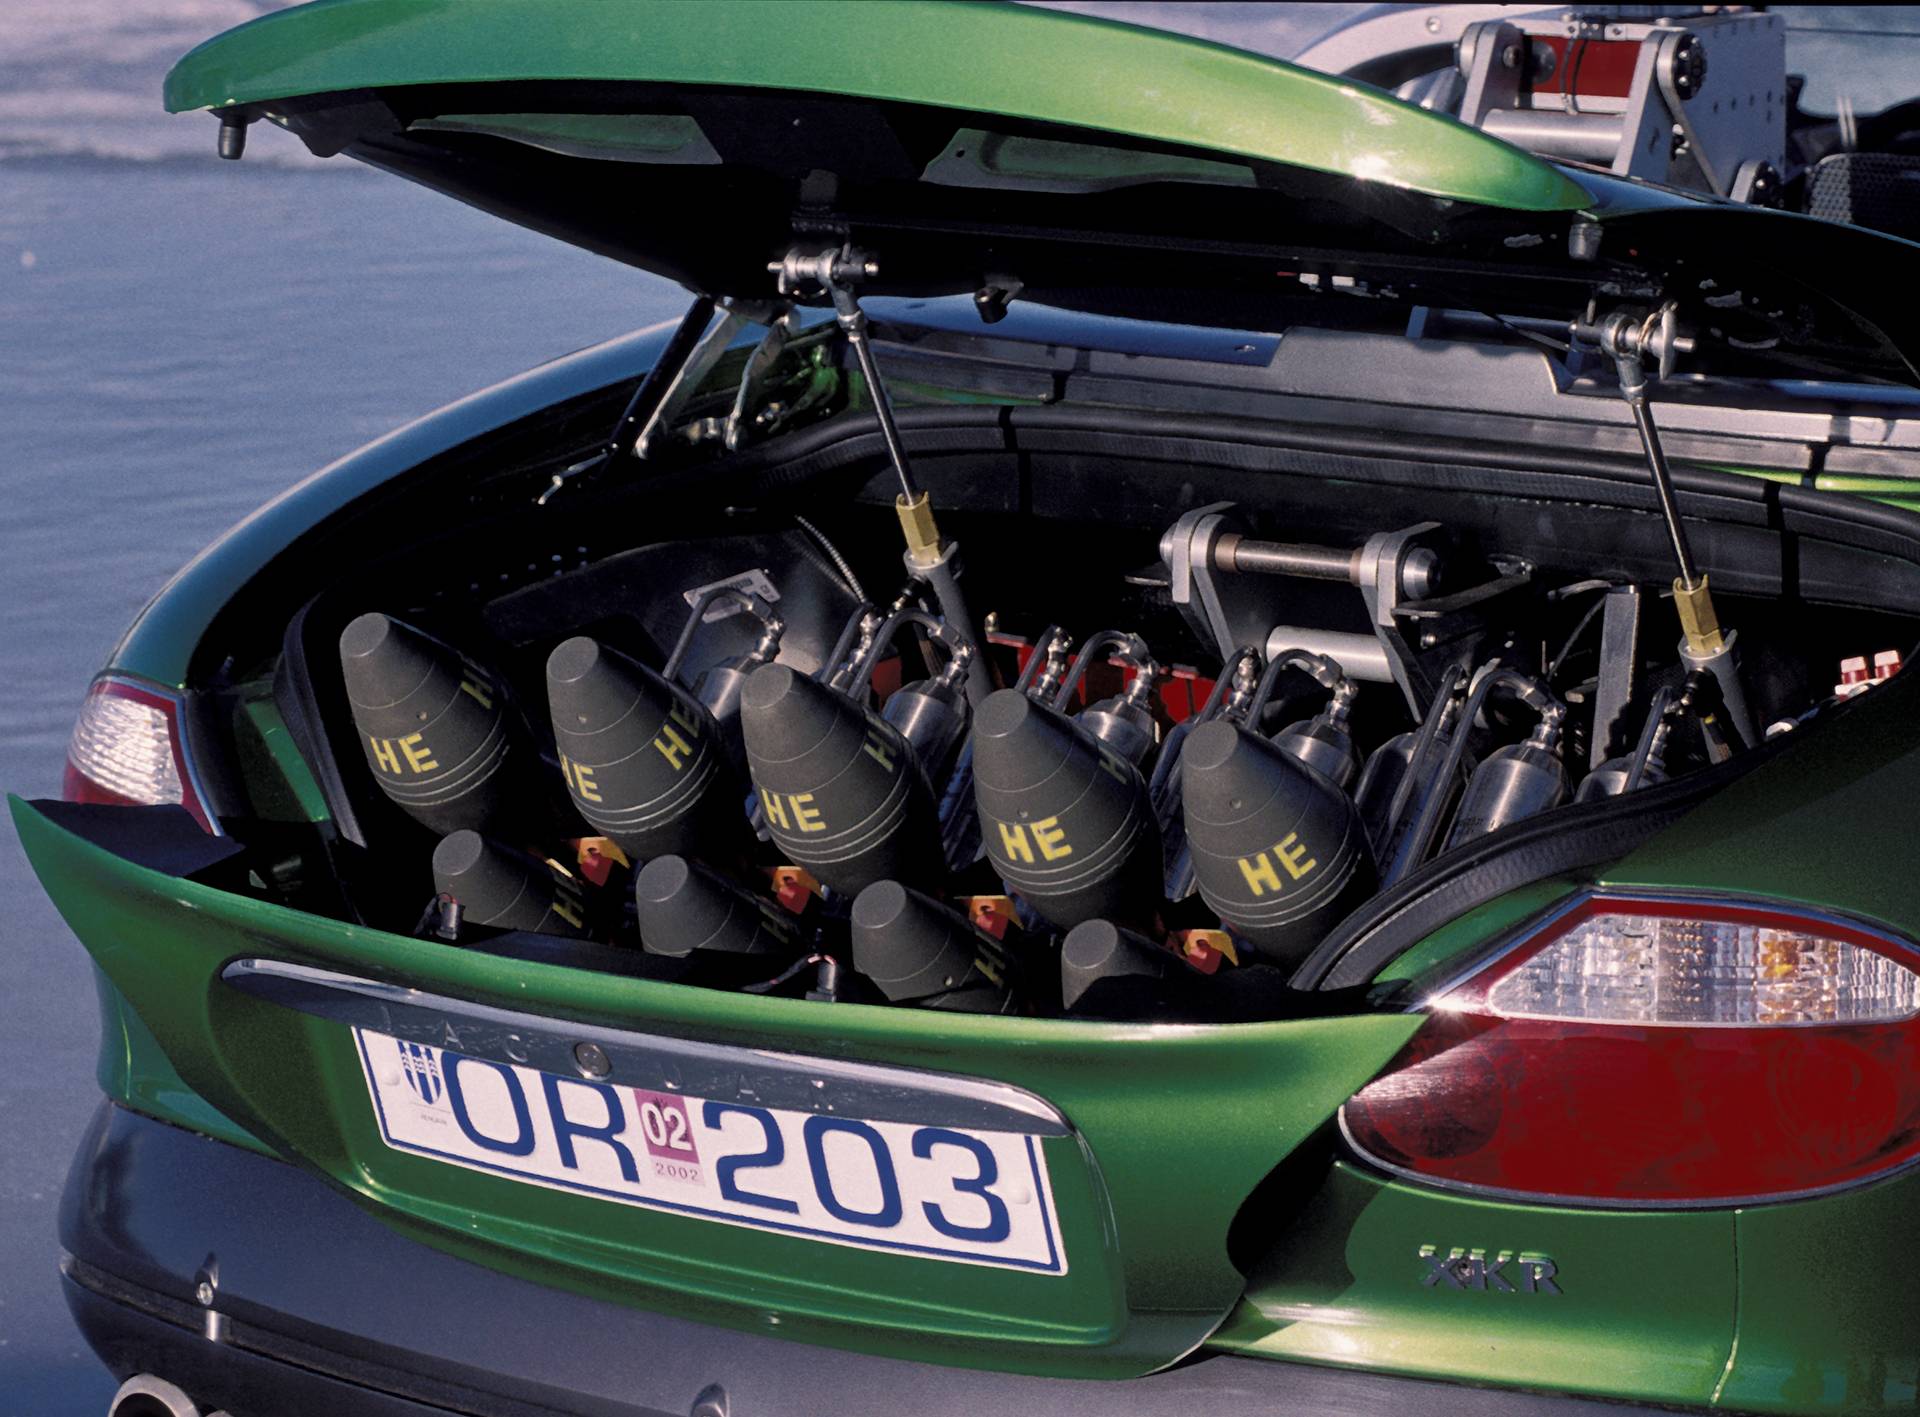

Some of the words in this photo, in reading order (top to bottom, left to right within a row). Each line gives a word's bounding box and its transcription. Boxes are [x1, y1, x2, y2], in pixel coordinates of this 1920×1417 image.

[370, 733, 439, 774] HE
[761, 788, 826, 832] HE
[998, 815, 1073, 863] HE
[1238, 831, 1317, 896] HE
[441, 1050, 640, 1184] OR
[702, 1100, 1011, 1243] 203
[641, 1101, 693, 1151] 02
[655, 1162, 699, 1181] 2002
[1418, 1244, 1564, 1295] XKR
